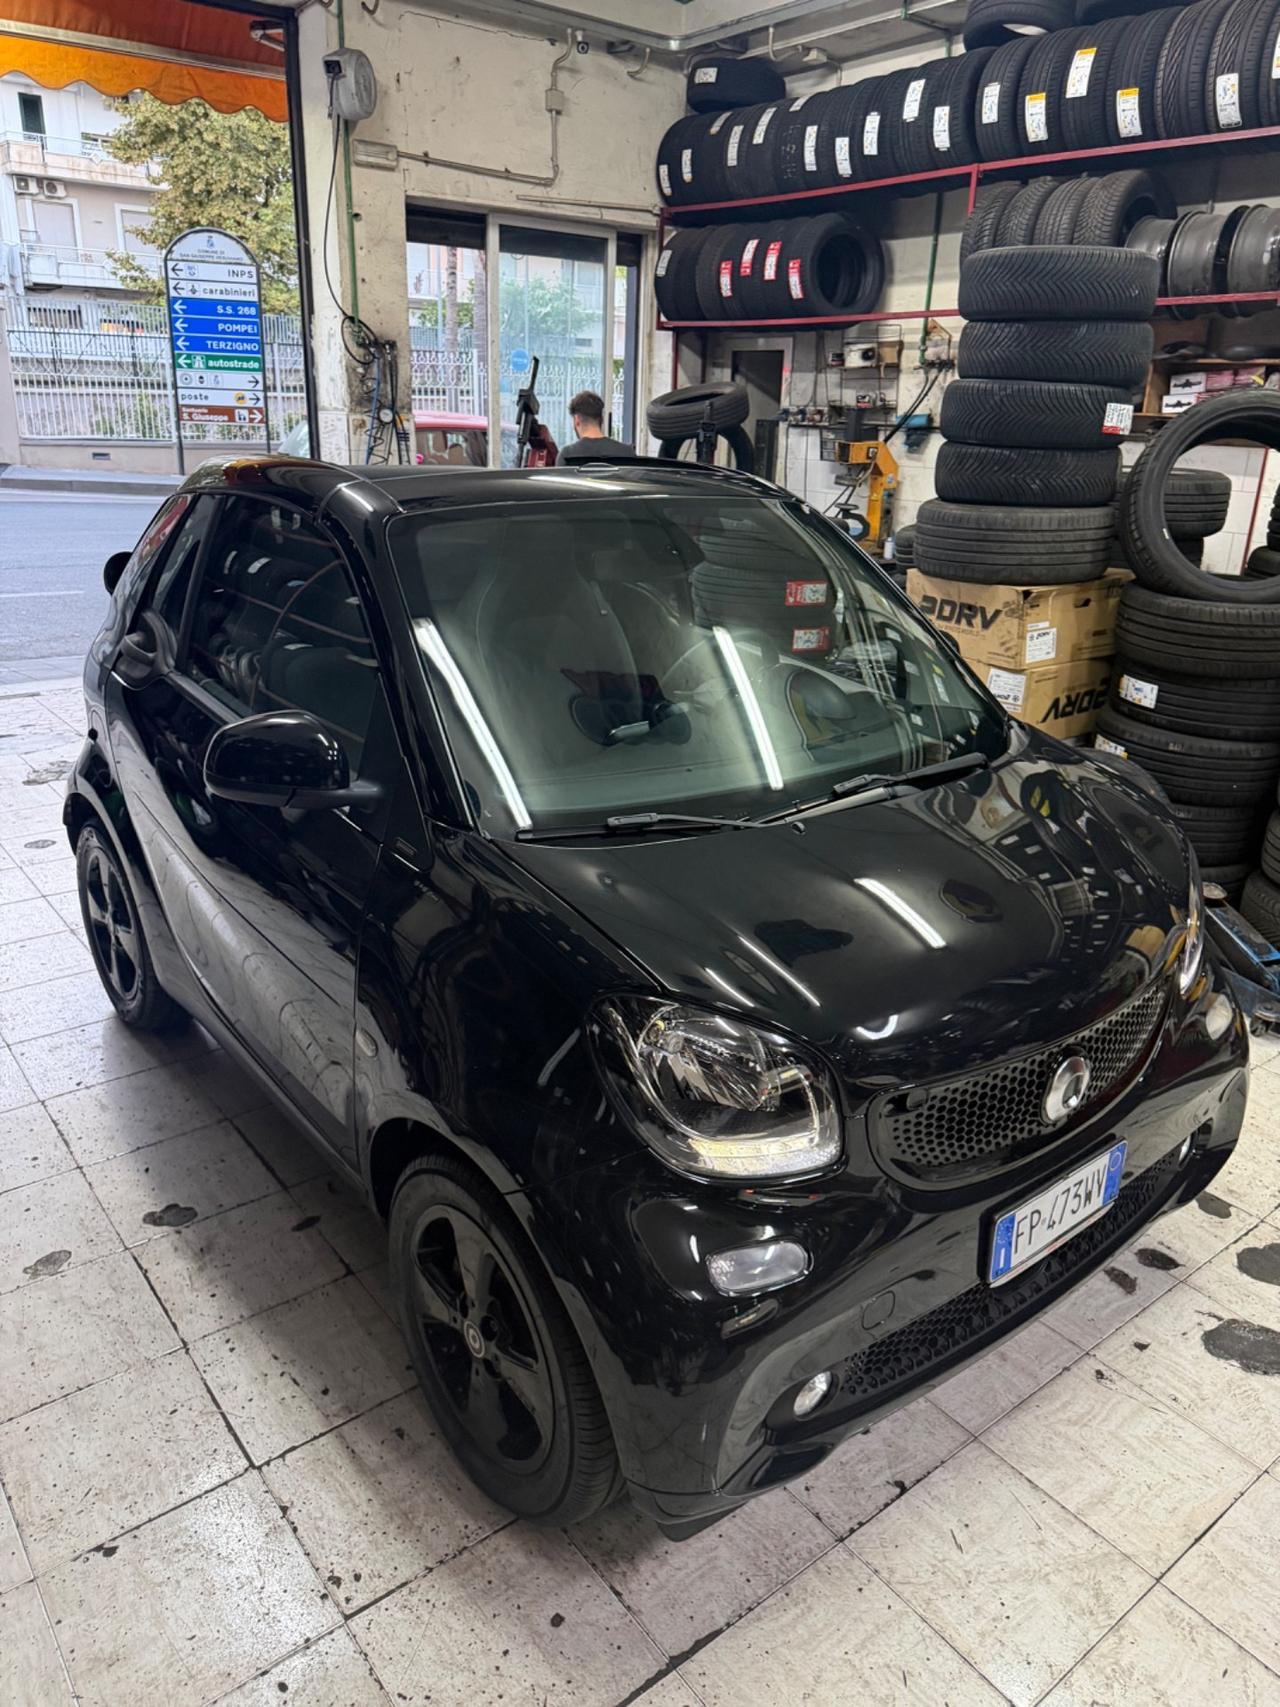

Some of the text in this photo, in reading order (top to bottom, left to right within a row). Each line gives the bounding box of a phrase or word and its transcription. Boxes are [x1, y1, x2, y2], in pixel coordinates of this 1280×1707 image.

[227, 269, 254, 279] INPS
[202, 287, 256, 297] carabinieri
[217, 305, 257, 316] S.S. 268
[217, 323, 258, 334] POMPEI
[206, 340, 259, 351] TERZIGNO
[207, 359, 260, 369] autostrade
[181, 393, 209, 401] poste
